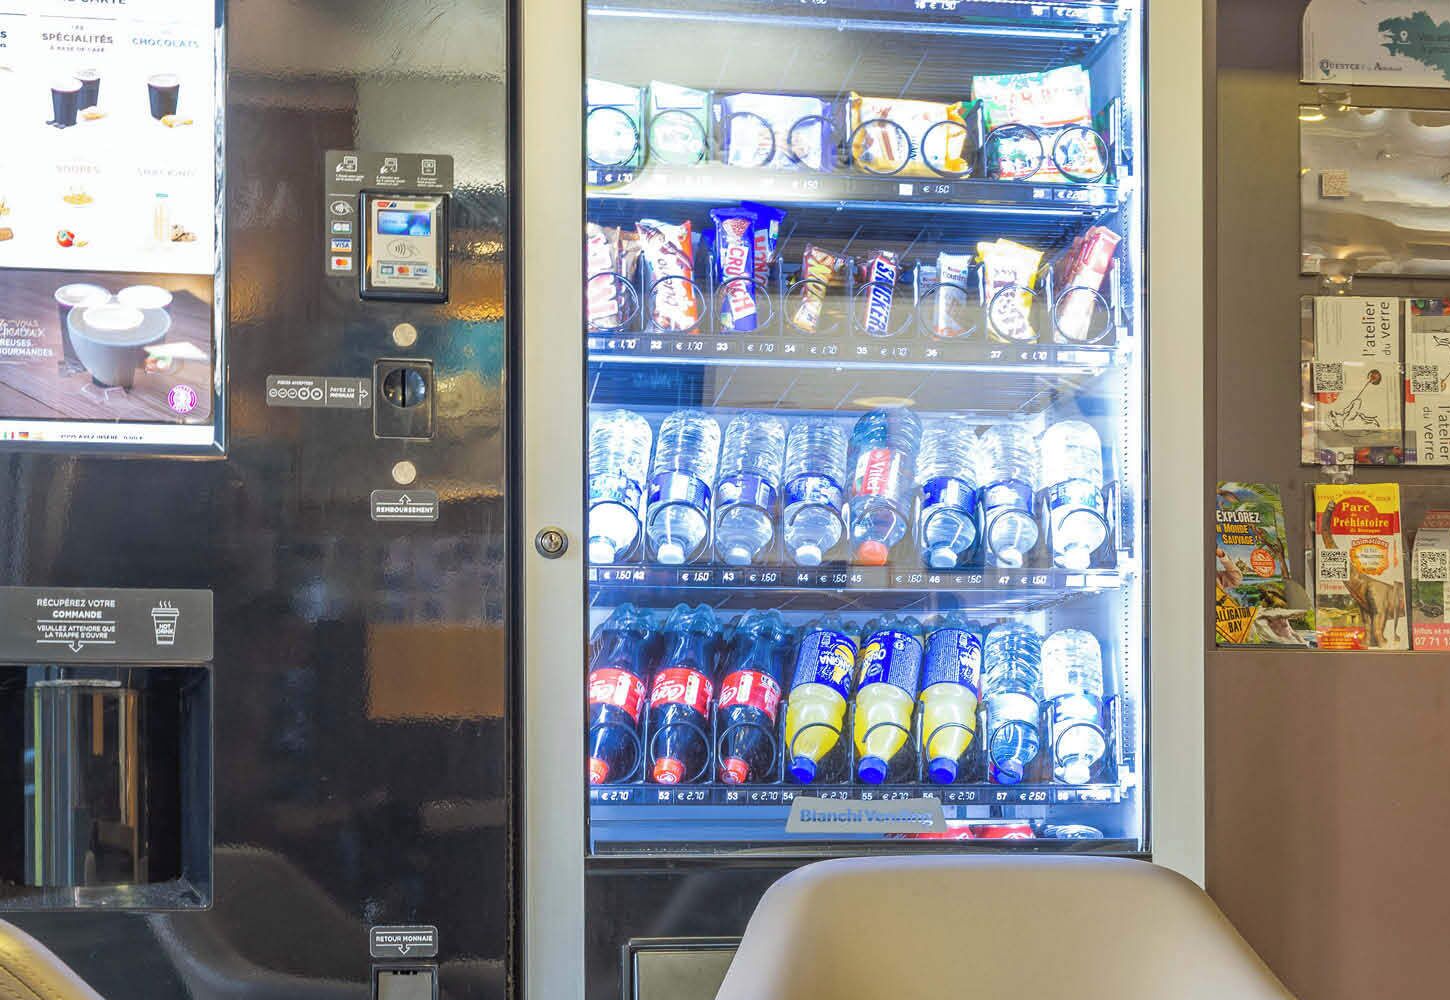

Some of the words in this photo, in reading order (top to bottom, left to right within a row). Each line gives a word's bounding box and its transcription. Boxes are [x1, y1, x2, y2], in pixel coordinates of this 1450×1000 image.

[42, 32, 114, 44] SPÉCIALITÉS
[132, 38, 200, 48] CHOCOLATS
[1381, 301, 1391, 341] verre
[1361, 300, 1376, 358] l'atelier
[1384, 344, 1391, 356] du
[1423, 406, 1433, 418] du
[1424, 422, 1434, 461] verre
[1341, 502, 1370, 512] Parc
[1216, 510, 1260, 523] EXPLOREZ
[1332, 516, 1390, 528] Préhistoire
[1222, 534, 1254, 545] SAUVAGE
[723, 572, 734, 581] 43
[797, 573, 809, 582] 44
[37, 598, 87, 608] RÉCUPÉREZ
[88, 600, 116, 608] VOTRE
[52, 611, 102, 619] COMMANDE
[1228, 620, 1243, 633] BAY
[1414, 637, 1426, 646] 07
[1429, 637, 1440, 646] 71
[727, 791, 738, 800] 53
[783, 792, 794, 800] 54
[862, 792, 873, 800] 55
[997, 792, 1008, 800] 57
[800, 808, 866, 822] Bianchi
[866, 808, 934, 825] Vending
